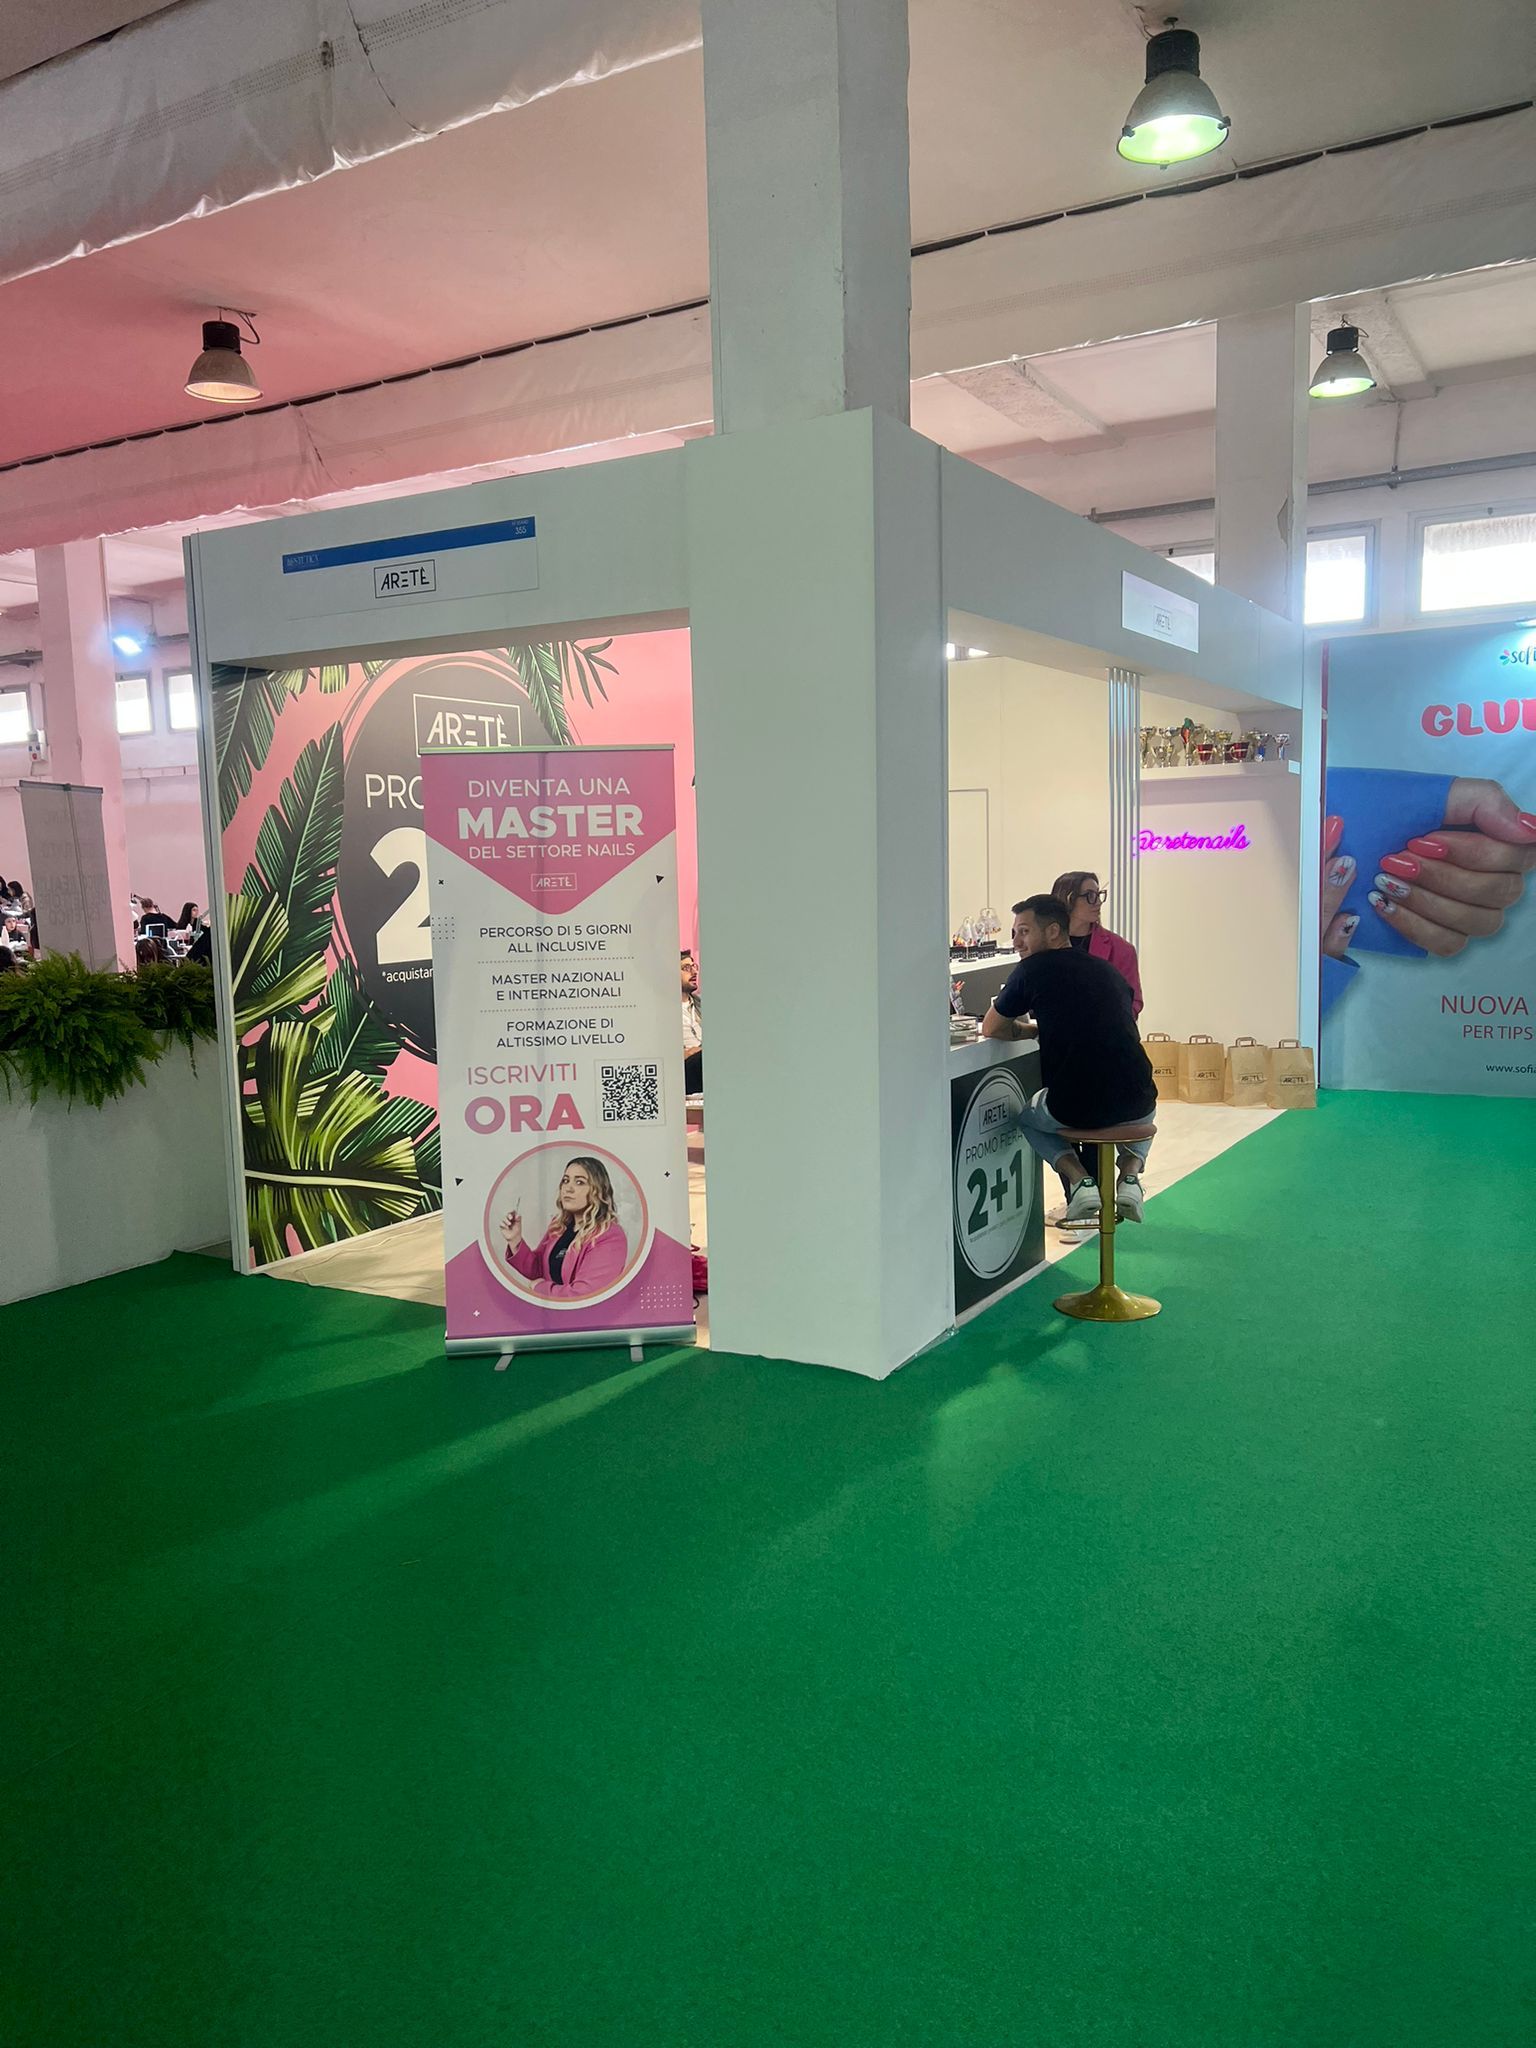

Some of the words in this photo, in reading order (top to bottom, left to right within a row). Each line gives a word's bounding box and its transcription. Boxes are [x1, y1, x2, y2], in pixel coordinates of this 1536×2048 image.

[468, 778, 572, 798] DIVENTA
[580, 777, 630, 795] UNA
[457, 804, 644, 840] MASTER
[469, 846, 500, 859] DEL
[507, 844, 581, 858] SETTORE
[588, 843, 635, 856] NAILS
[480, 926, 553, 937] PERCORSO
[557, 926, 570, 936] DI
[575, 926, 582, 935] 5
[586, 924, 632, 935] GIORNI
[508, 942, 533, 953] ALL
[537, 940, 606, 952] INCLUSIVE
[492, 974, 547, 985] MASTER
[551, 972, 624, 983] NAZIONALI
[497, 991, 504, 1000] E
[509, 987, 621, 1000] INTERNAZIONALI
[1441, 995, 1529, 1015] NUOVA
[507, 1020, 596, 1031] FORMAZIONE
[600, 1019, 613, 1028] DI
[1463, 1025, 1493, 1038] PER
[1497, 1026, 1533, 1040] TIPS
[496, 1036, 567, 1047] ALTISSIMO
[571, 1034, 625, 1045] LIVELLO
[468, 1064, 577, 1085] ISCRIVITI
[464, 1093, 584, 1134] ORA
[965, 1137, 999, 1163] PROMO
[967, 1149, 1023, 1236] 2+1
